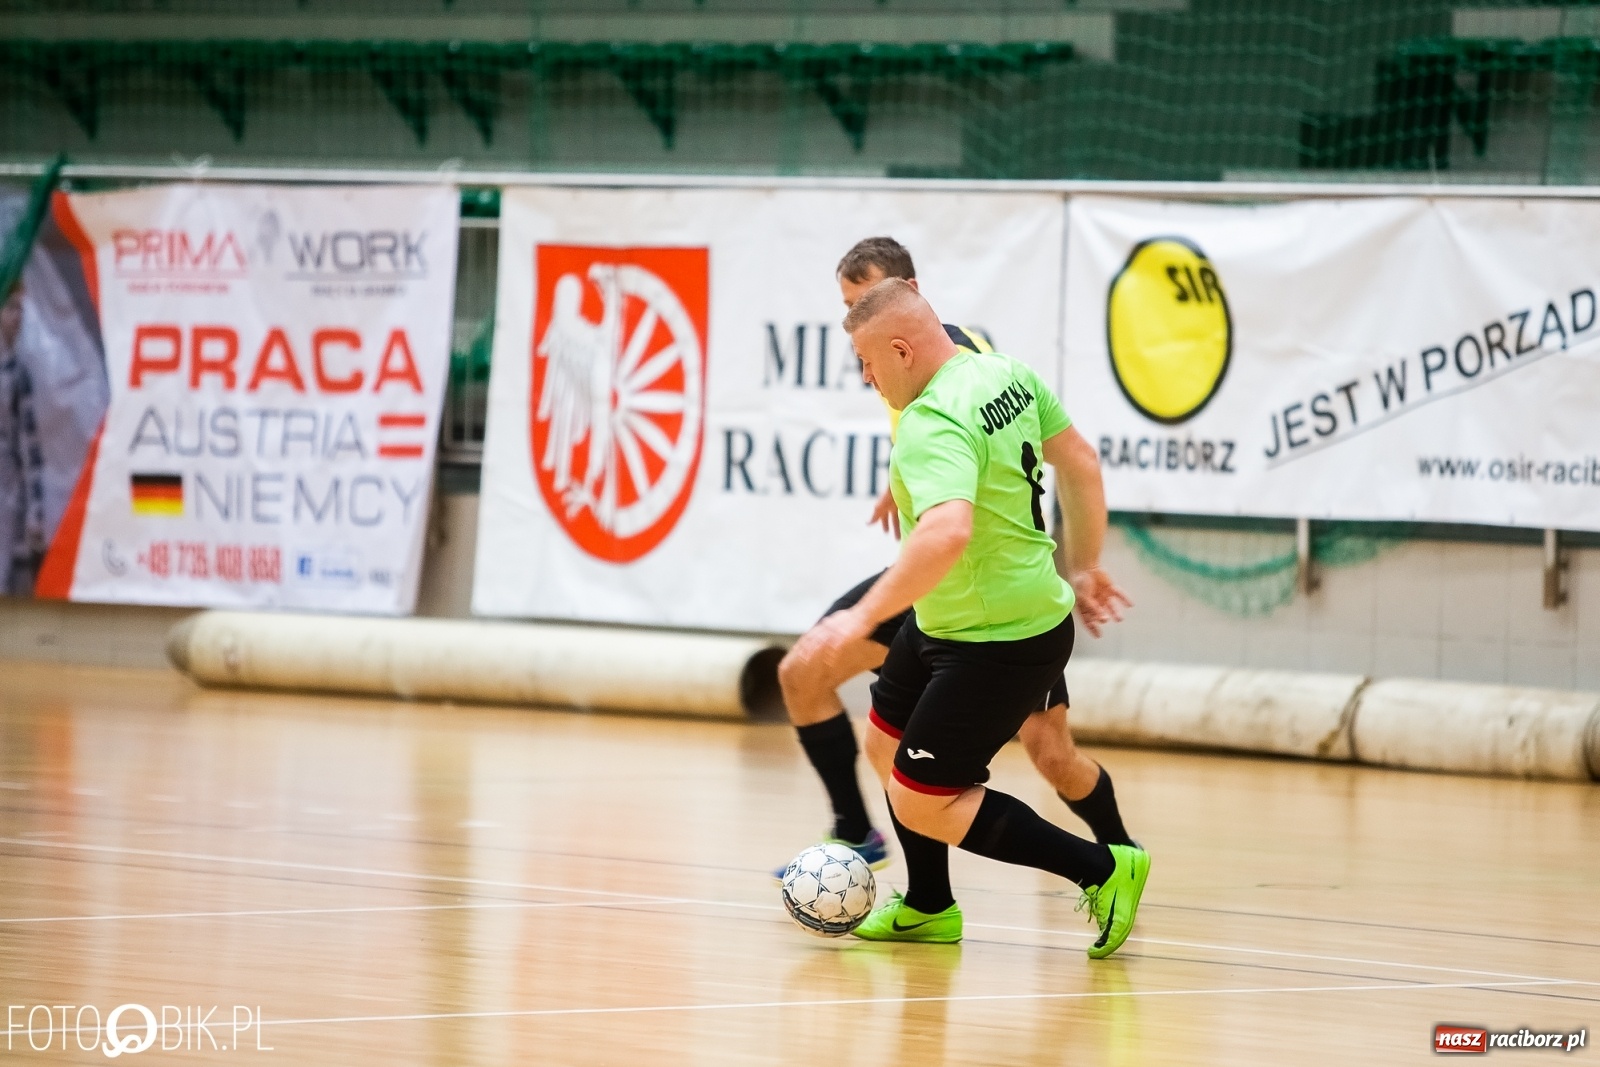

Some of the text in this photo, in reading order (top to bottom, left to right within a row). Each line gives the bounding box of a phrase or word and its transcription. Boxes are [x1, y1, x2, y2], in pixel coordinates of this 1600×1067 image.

[288, 231, 427, 272] WORK
[129, 325, 424, 394] PRACA
[129, 406, 367, 459] AUSTRIA
[1264, 379, 1360, 458] JEST
[1373, 358, 1407, 411] W
[722, 427, 895, 498] RACIB
[1418, 454, 1600, 486] www.osir-racib
[194, 474, 420, 527] NIEMCY
